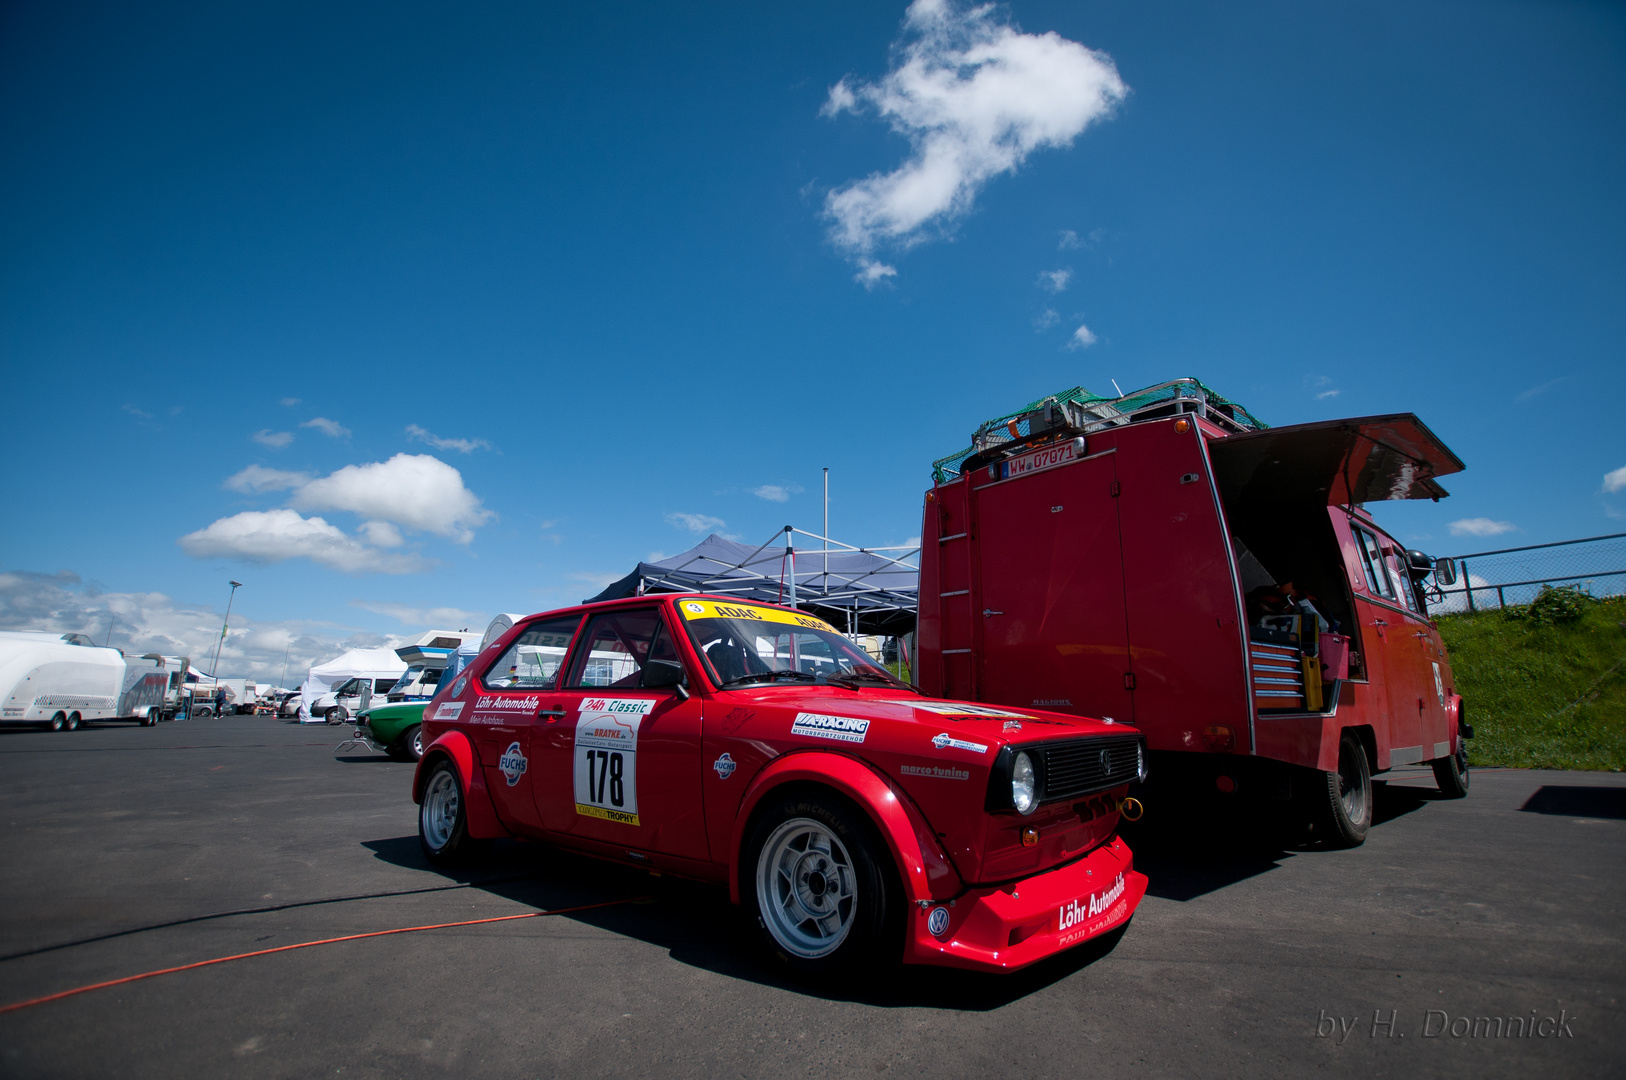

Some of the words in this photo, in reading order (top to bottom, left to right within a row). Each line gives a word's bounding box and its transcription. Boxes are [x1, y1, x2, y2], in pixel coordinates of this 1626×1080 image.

[1010, 458, 1026, 474] WW
[1033, 445, 1074, 468] 07071
[689, 603, 702, 613] 3
[713, 606, 763, 620] ADAC
[475, 695, 491, 708] Löhr
[491, 695, 540, 709] Automobile
[583, 699, 606, 711] 24h
[607, 700, 648, 713] Classic
[932, 737, 951, 745] FUCHS
[501, 757, 526, 771] FUCHS
[714, 761, 736, 771] FUCHS
[586, 749, 624, 807] 178
[1059, 899, 1087, 931] Löhr
[1087, 871, 1125, 918] Automobile
